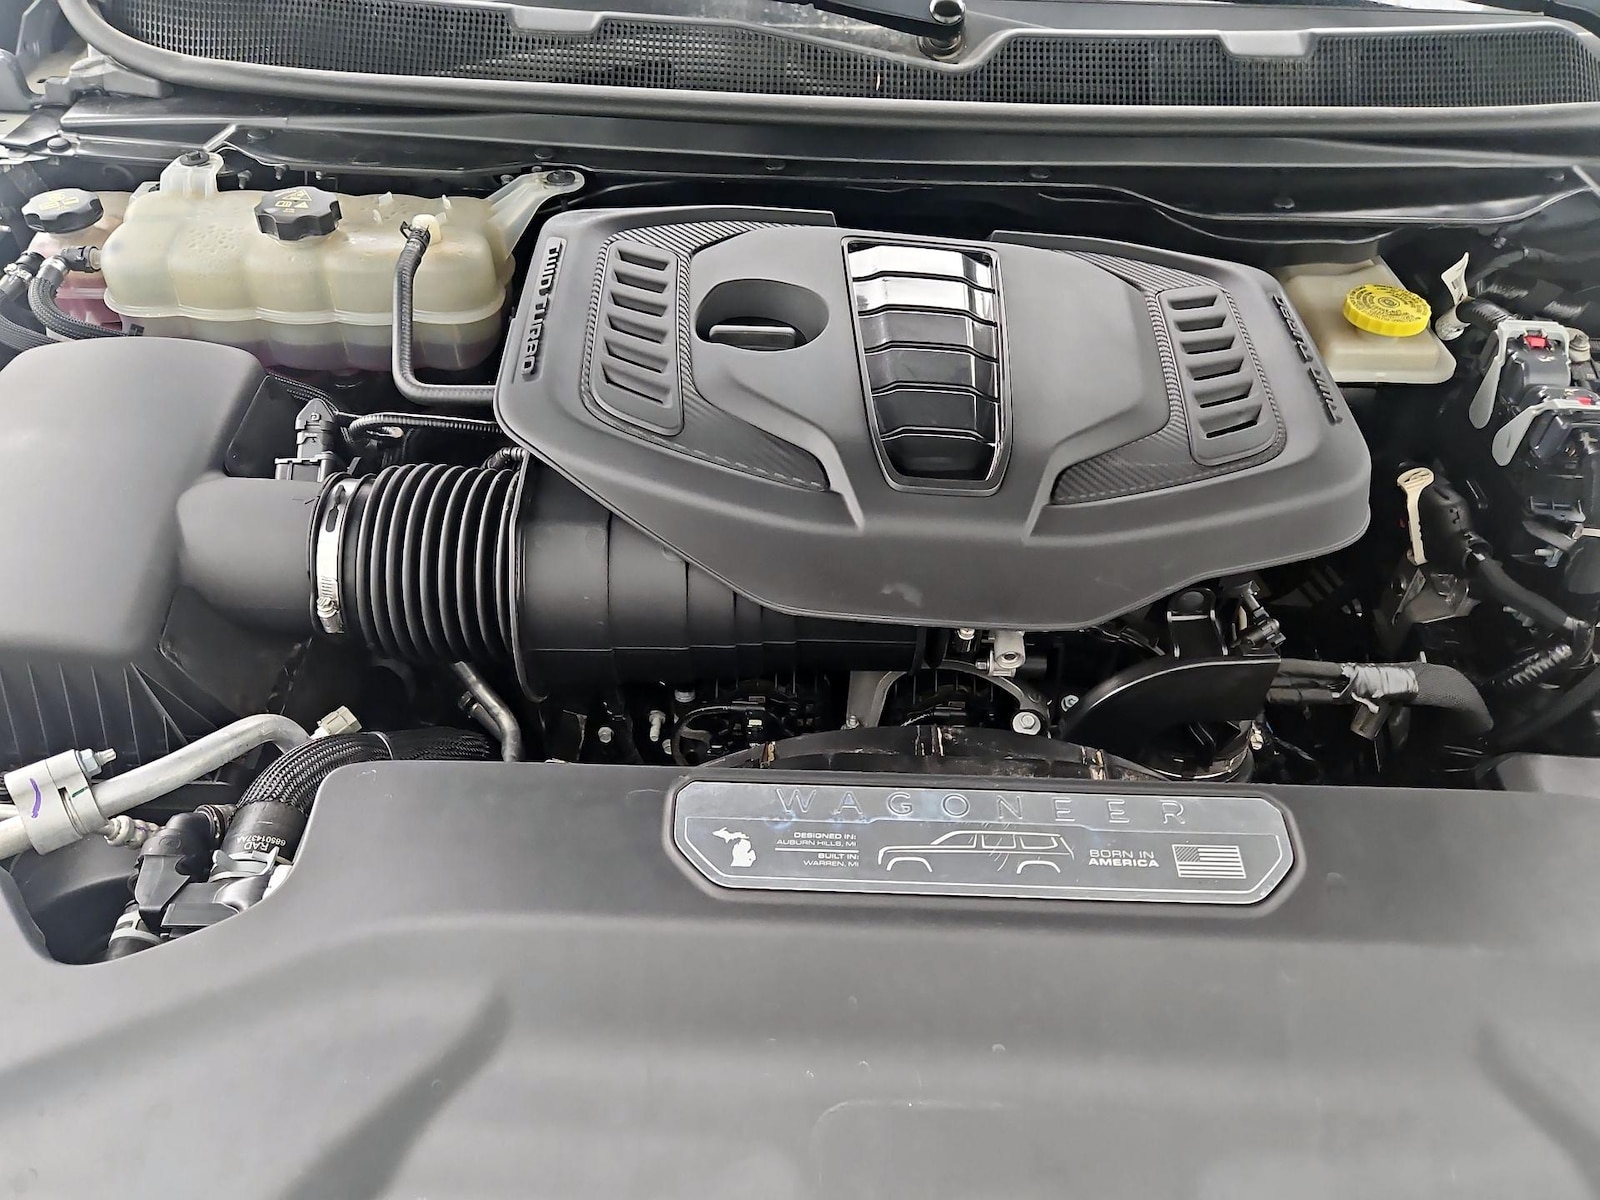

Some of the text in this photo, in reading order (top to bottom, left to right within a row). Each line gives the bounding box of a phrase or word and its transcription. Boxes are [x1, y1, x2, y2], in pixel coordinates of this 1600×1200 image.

[521, 294, 549, 376] TURBO
[775, 788, 1186, 825] WAGONEER
[793, 832, 842, 840] DESIGNED
[243, 841, 269, 851] RAD
[817, 852, 844, 860] BUILT
[1089, 849, 1155, 859] BORN IN
[1088, 857, 1160, 868] AMERICA
